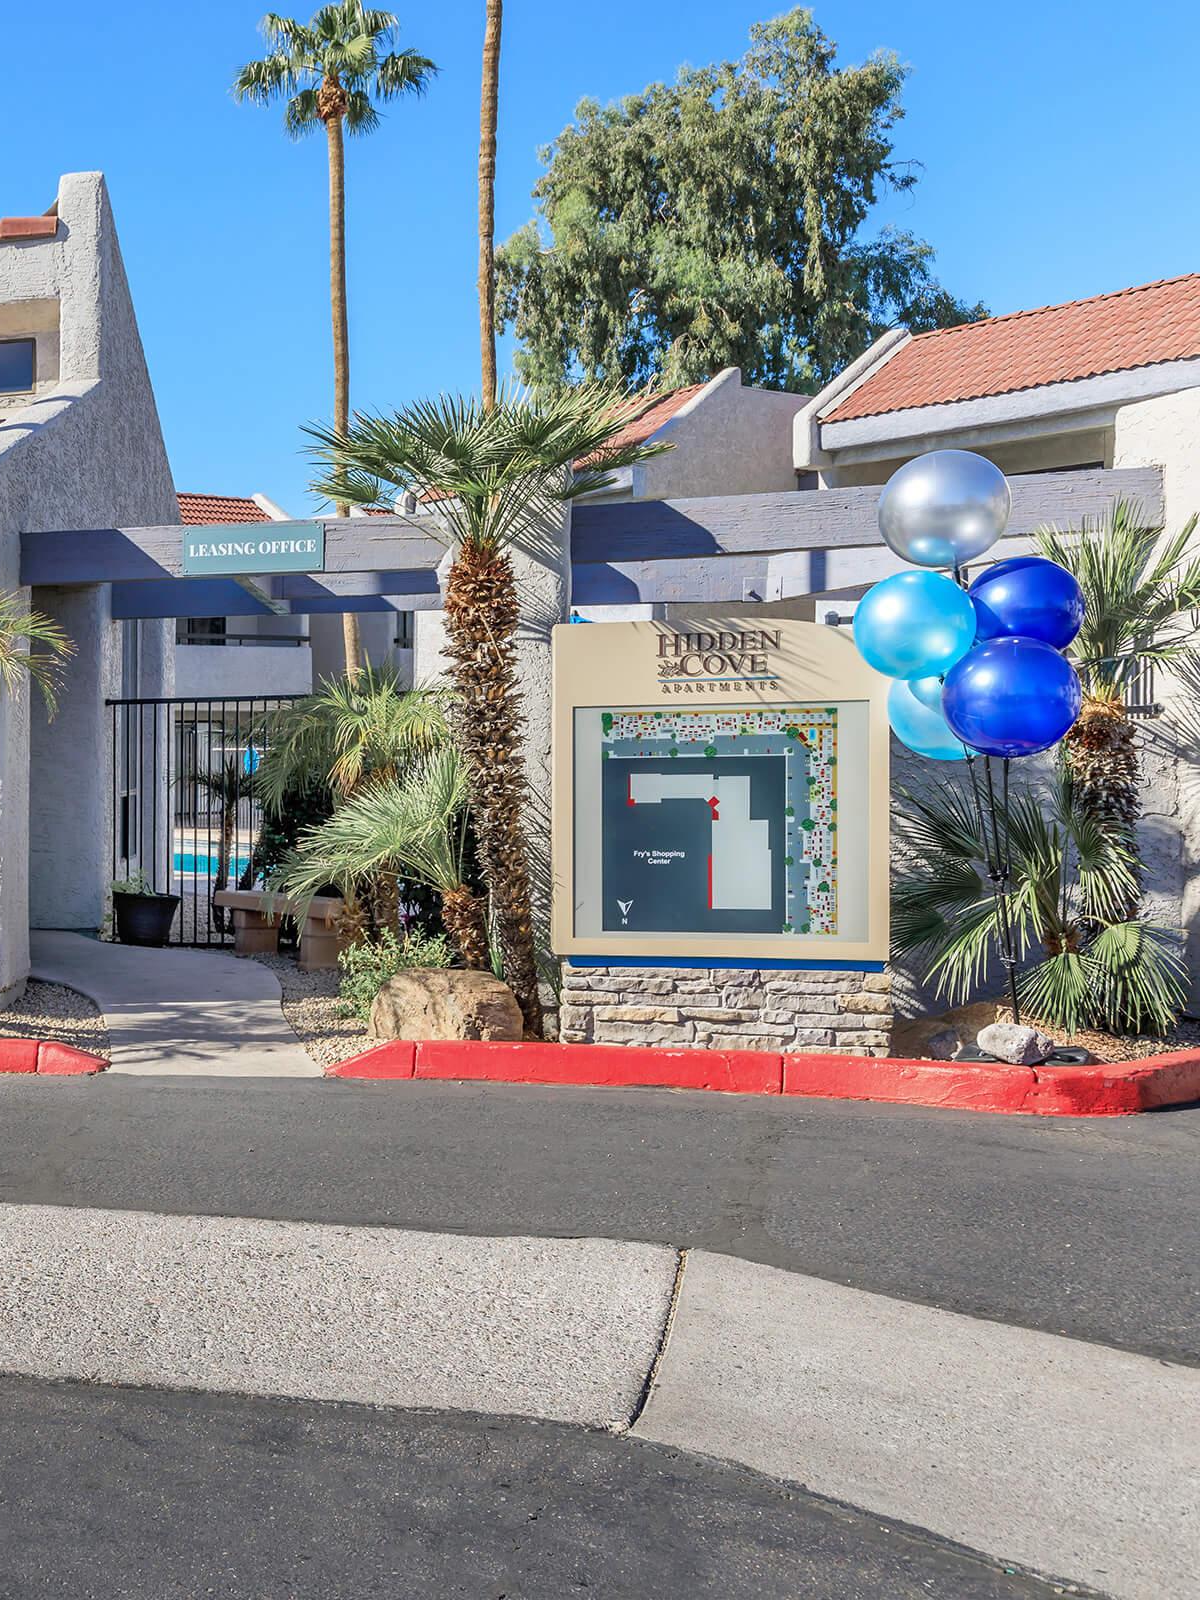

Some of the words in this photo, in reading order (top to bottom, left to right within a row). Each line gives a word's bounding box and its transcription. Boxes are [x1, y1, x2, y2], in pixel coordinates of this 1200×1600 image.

[189, 542, 255, 557] LEASING
[258, 539, 316, 554] OFFICE
[656, 630, 782, 658] HIDDEN
[679, 653, 769, 677] COVE
[661, 680, 779, 694] APARTMENTS
[633, 850, 650, 858] Fry's
[651, 850, 685, 858] Shopping
